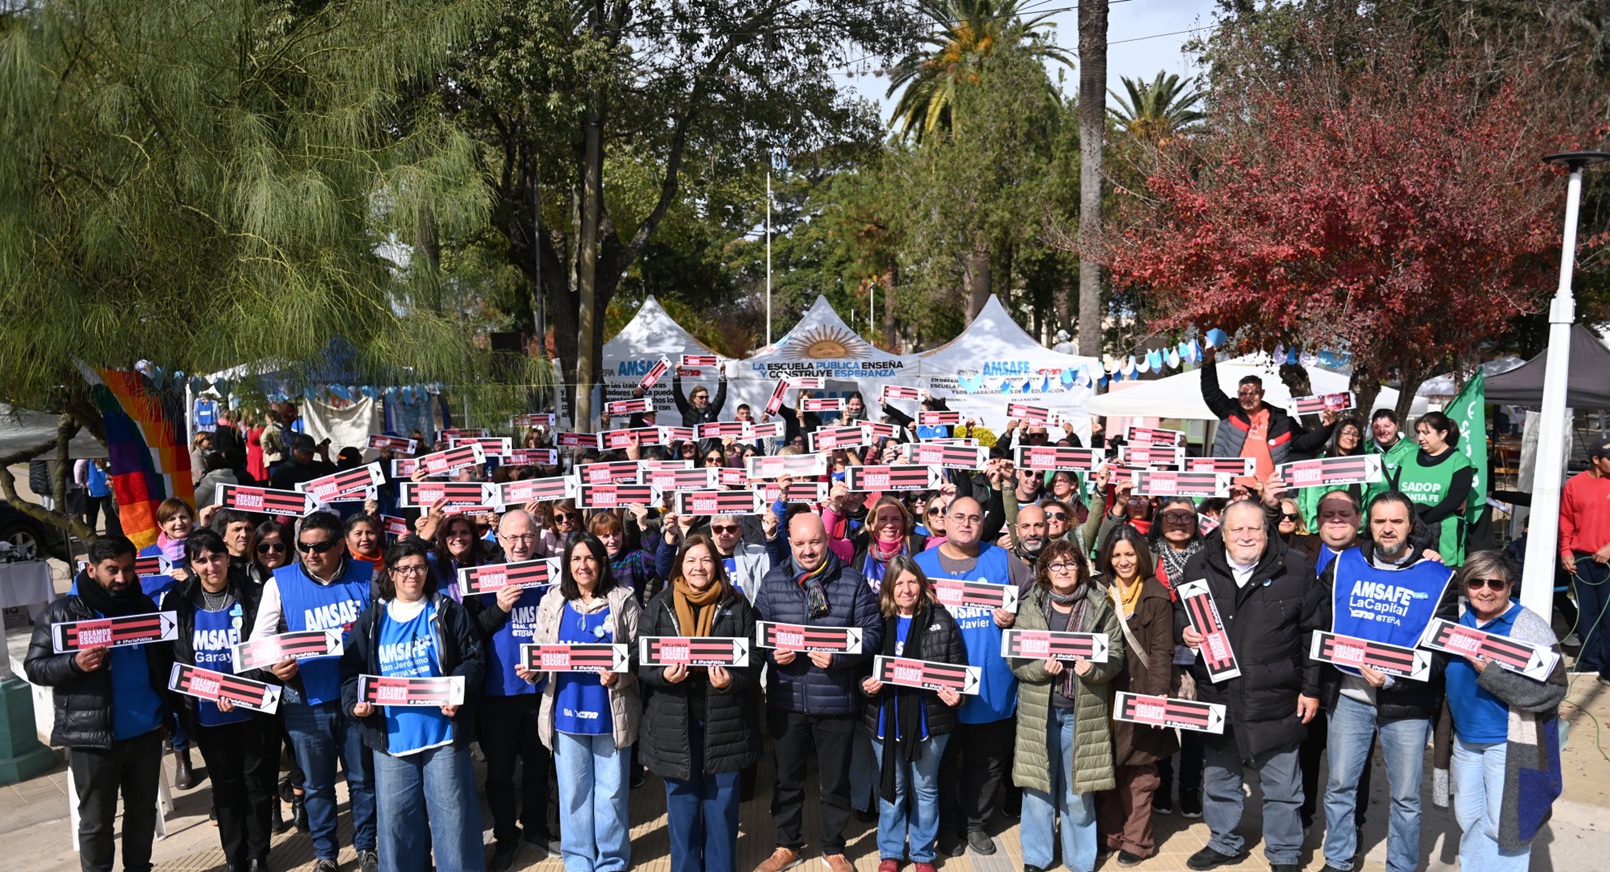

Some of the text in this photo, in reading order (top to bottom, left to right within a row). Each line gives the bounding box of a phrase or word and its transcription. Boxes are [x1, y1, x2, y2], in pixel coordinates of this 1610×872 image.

[752, 360, 903, 371] LA ESCUELA PÚBLICA ENSEÑA
[760, 370, 767, 378] Y
[834, 369, 896, 378] ESPERANZA
[1295, 469, 1322, 477] CREAMOS
[1295, 475, 1323, 483] ESCUELA
[1401, 481, 1441, 493] SADOP
[1429, 494, 1440, 502] FE
[236, 500, 263, 508] ESCUELA
[480, 574, 507, 582] CREAMOS
[480, 579, 508, 588] ESCUELA
[937, 588, 963, 596] CREAMOS
[1351, 580, 1414, 607] AMSAFE
[936, 593, 962, 602] ESCUELA
[1349, 596, 1409, 617] LaCapital
[960, 618, 990, 630] Javier
[79, 629, 111, 639] CREAMOS
[777, 632, 804, 640] CREAMOS
[79, 635, 112, 645] ESCUELA
[777, 637, 804, 646] ESCUELA
[1450, 634, 1482, 648] CREAMOS
[1334, 644, 1365, 655] CREAMOS
[1448, 639, 1479, 653] ESCUELA
[195, 651, 231, 663] Garay
[1333, 650, 1364, 662] ESCUELA
[895, 667, 922, 676] CREAMOS
[894, 672, 922, 682] ESCUELA
[192, 677, 220, 689] CREAMOS
[190, 682, 219, 696] ESCUELA
[378, 693, 407, 701] ESCUELA
[1136, 704, 1165, 713] CREAMOS
[1136, 710, 1165, 719] ESCUELA
